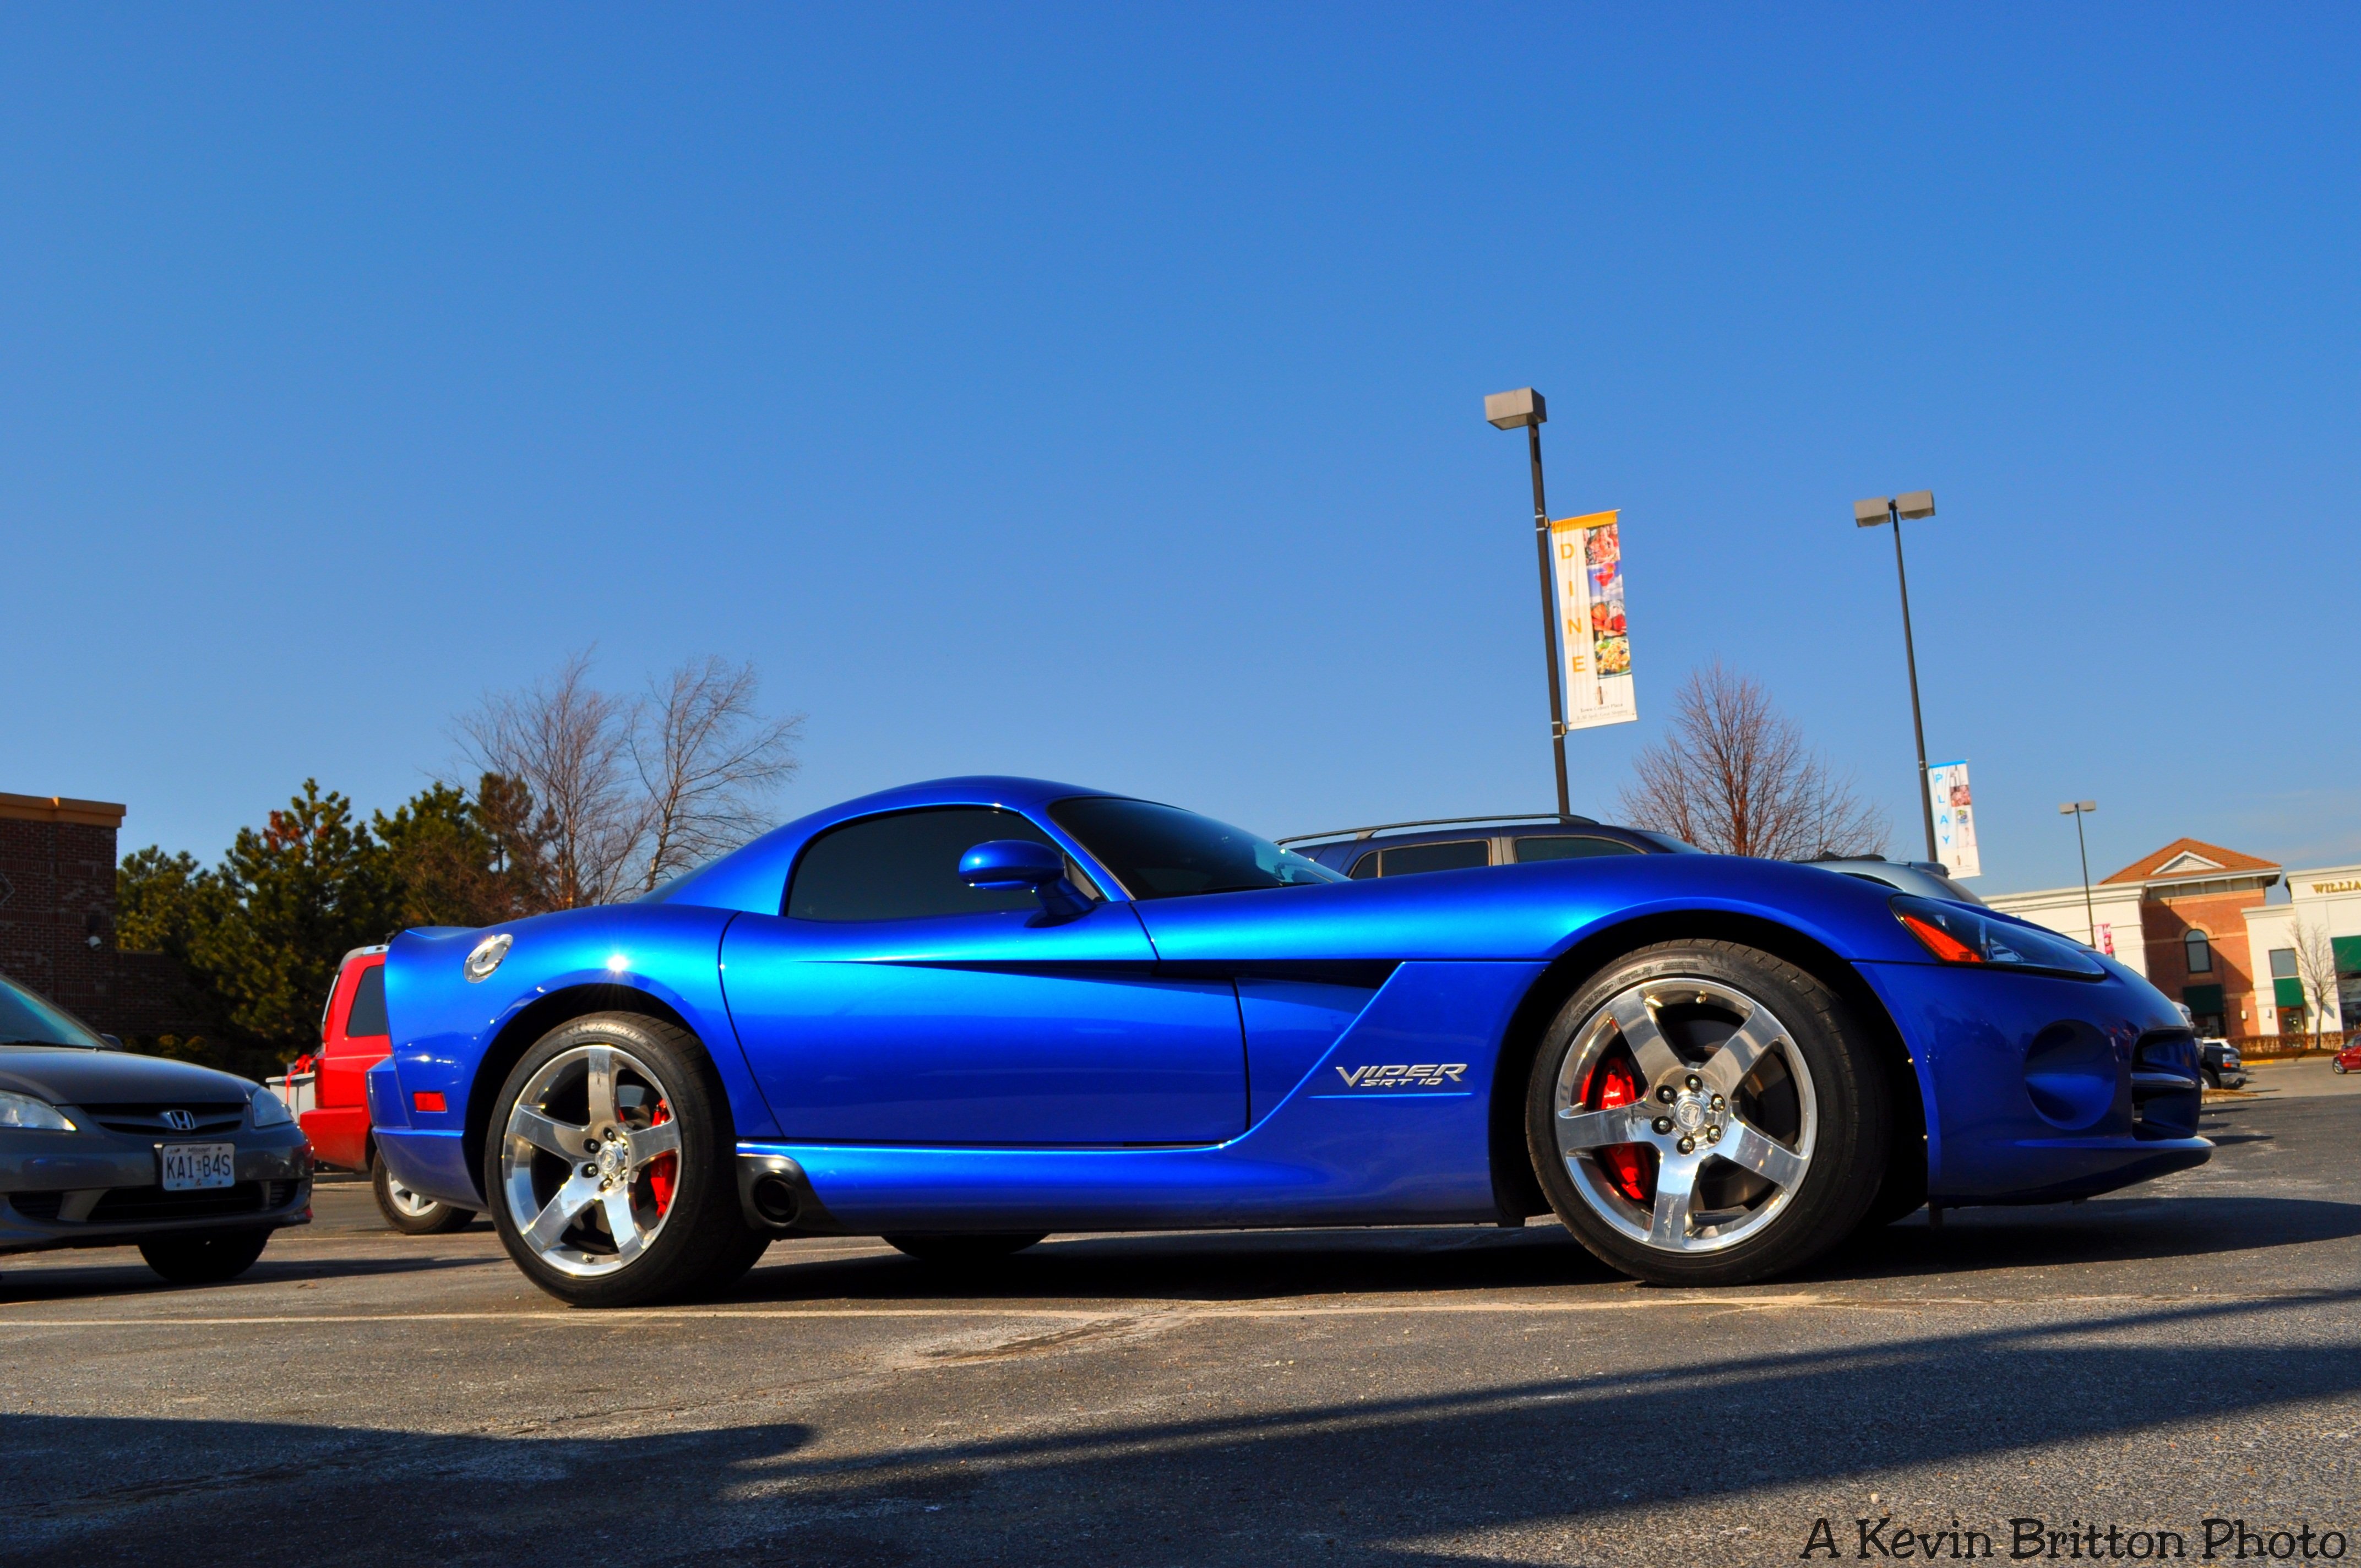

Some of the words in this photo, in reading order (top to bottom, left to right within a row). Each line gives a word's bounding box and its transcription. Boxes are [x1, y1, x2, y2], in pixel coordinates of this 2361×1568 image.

[1560, 543, 1586, 673] DINE
[1935, 774, 1950, 844] PLAY
[1335, 1063, 1468, 1088] VIPER
[1360, 1077, 1414, 1088] SRT
[1417, 1077, 1443, 1086] 10
